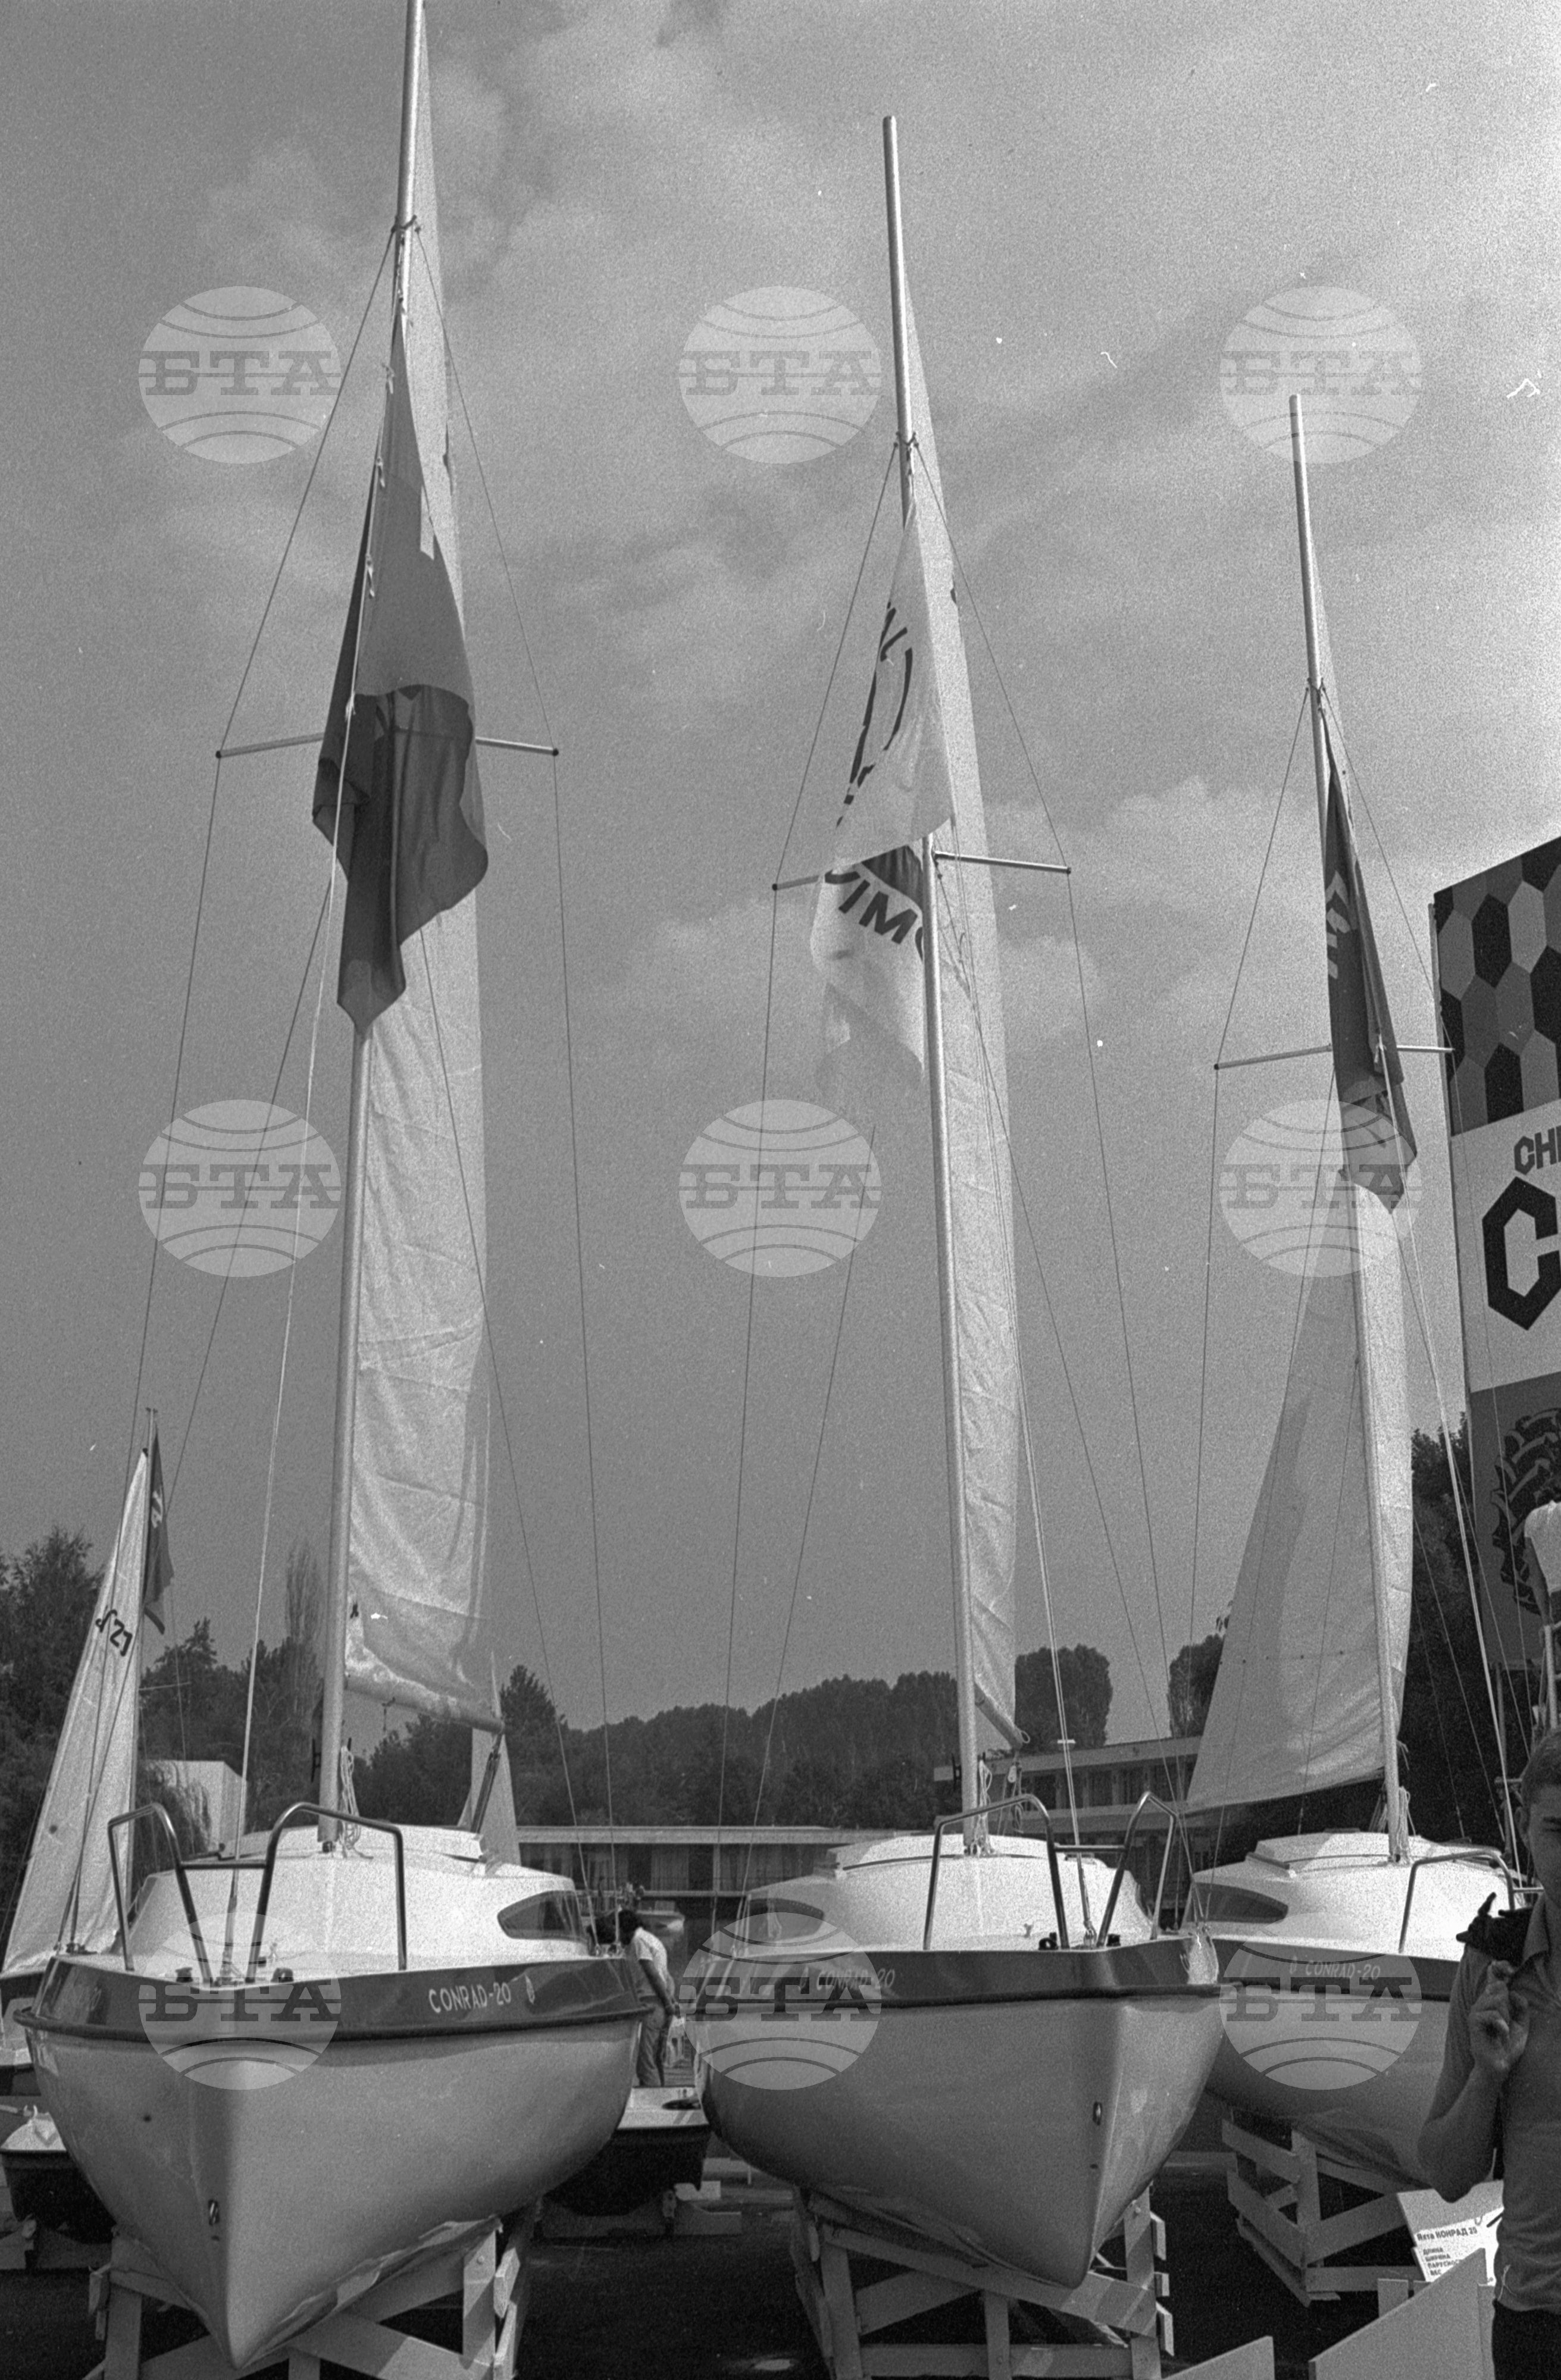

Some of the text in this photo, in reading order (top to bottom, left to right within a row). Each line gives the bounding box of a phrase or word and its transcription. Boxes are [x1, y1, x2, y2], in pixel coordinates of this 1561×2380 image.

[1513, 1125, 1561, 1176] CH
[1305, 1960, 1381, 1981] CONRAD-20
[428, 1981, 511, 2013] CONRAD-20
[1435, 2228, 1468, 2239] КОНРАД
